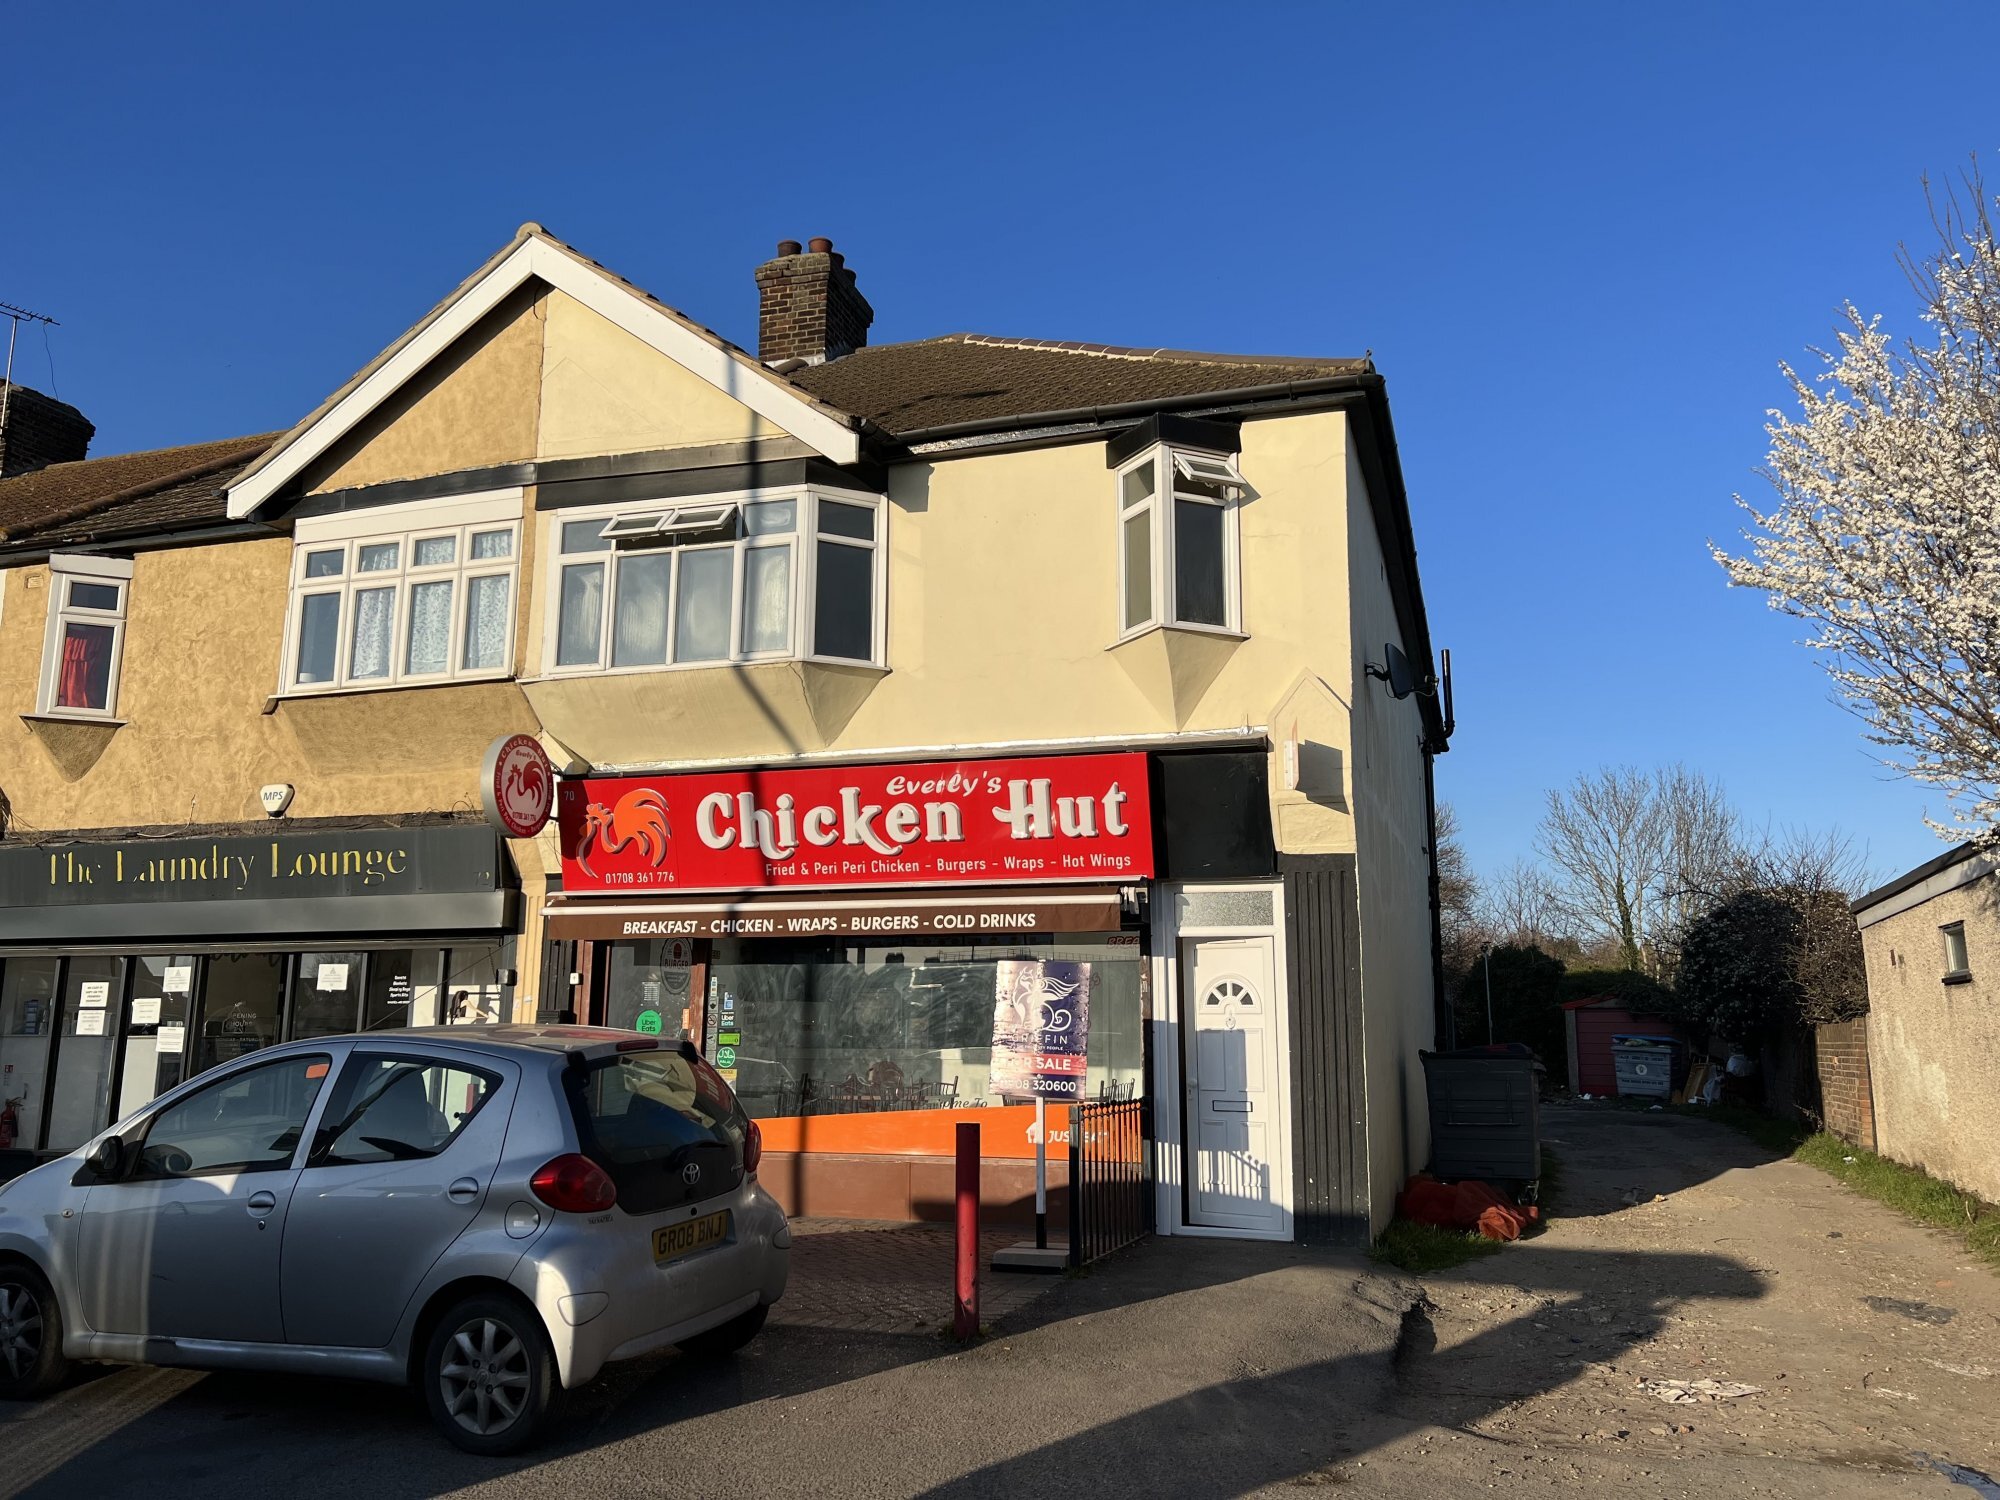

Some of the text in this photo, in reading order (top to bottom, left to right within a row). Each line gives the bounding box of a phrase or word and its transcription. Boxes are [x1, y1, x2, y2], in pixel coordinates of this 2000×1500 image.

[500, 737, 549, 767] Chicken Hut
[886, 770, 1003, 798] Everly's
[263, 791, 284, 801] MPS
[564, 790, 575, 801] 70
[695, 778, 1129, 861] Chicken Hut
[116, 844, 255, 891] Laundry
[272, 842, 407, 886] Lounge
[765, 862, 796, 877] Fried
[800, 863, 810, 875] &
[814, 861, 838, 876] Peri
[842, 860, 866, 875] Peri
[871, 858, 920, 874] Chicken
[937, 858, 986, 873] Burgers
[1004, 855, 1044, 872] Wraps
[1062, 854, 1085, 869] Hot
[1090, 853, 1132, 870] Wings
[605, 871, 675, 884] 01708 361 776
[623, 920, 698, 935] BREAKFAST
[710, 919, 774, 933] CHICKEN
[787, 917, 838, 931] WRAPS
[851, 915, 919, 930] BURGERS
[933, 914, 975, 929] COLD
[980, 913, 1036, 928] DRINKS
[664, 958, 689, 970] BURGER
[641, 1018, 656, 1026] Uber
[1036, 1056, 1072, 1071] SALE
[1032, 1079, 1077, 1092] 320600
[974, 1097, 988, 1108] To
[1048, 1130, 1070, 1144] JUS
[657, 1214, 723, 1256] GR08 BNJ
